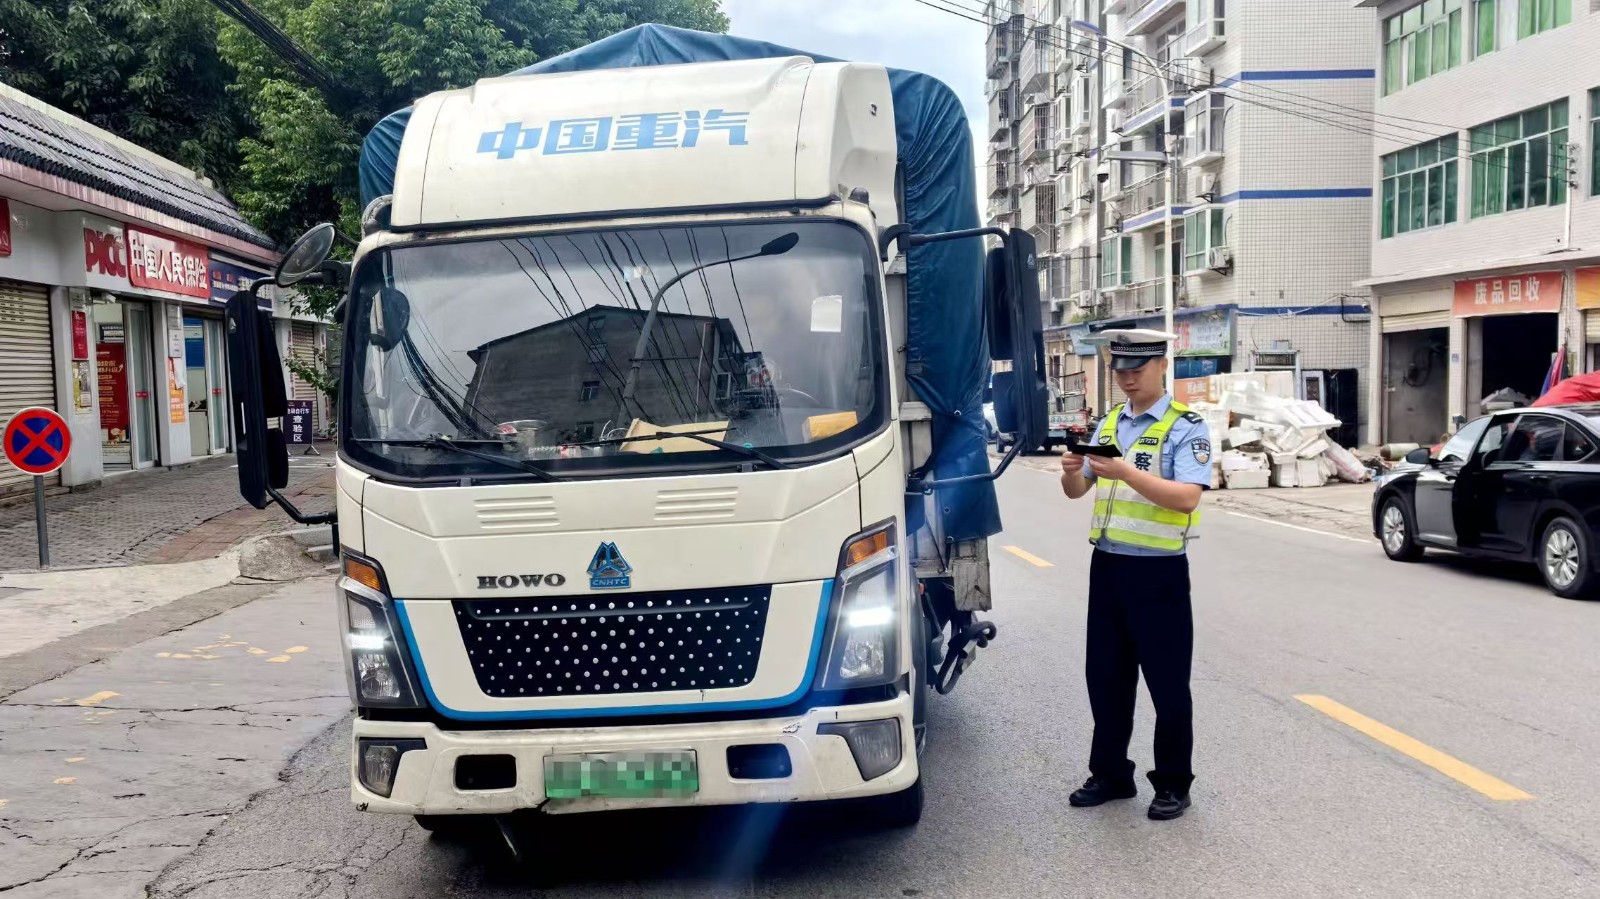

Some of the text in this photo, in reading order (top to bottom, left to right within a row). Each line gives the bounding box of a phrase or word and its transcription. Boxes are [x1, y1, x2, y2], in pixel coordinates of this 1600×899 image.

[476, 108, 750, 160] 中国重汽
[84, 227, 126, 278] PICC
[131, 235, 208, 289] 中国人民保险
[1474, 276, 1541, 305] 废品回收
[292, 415, 303, 442] 查验区
[1134, 452, 1152, 471] 察
[477, 573, 566, 589] HOWO
[592, 578, 628, 587] CNHTC
